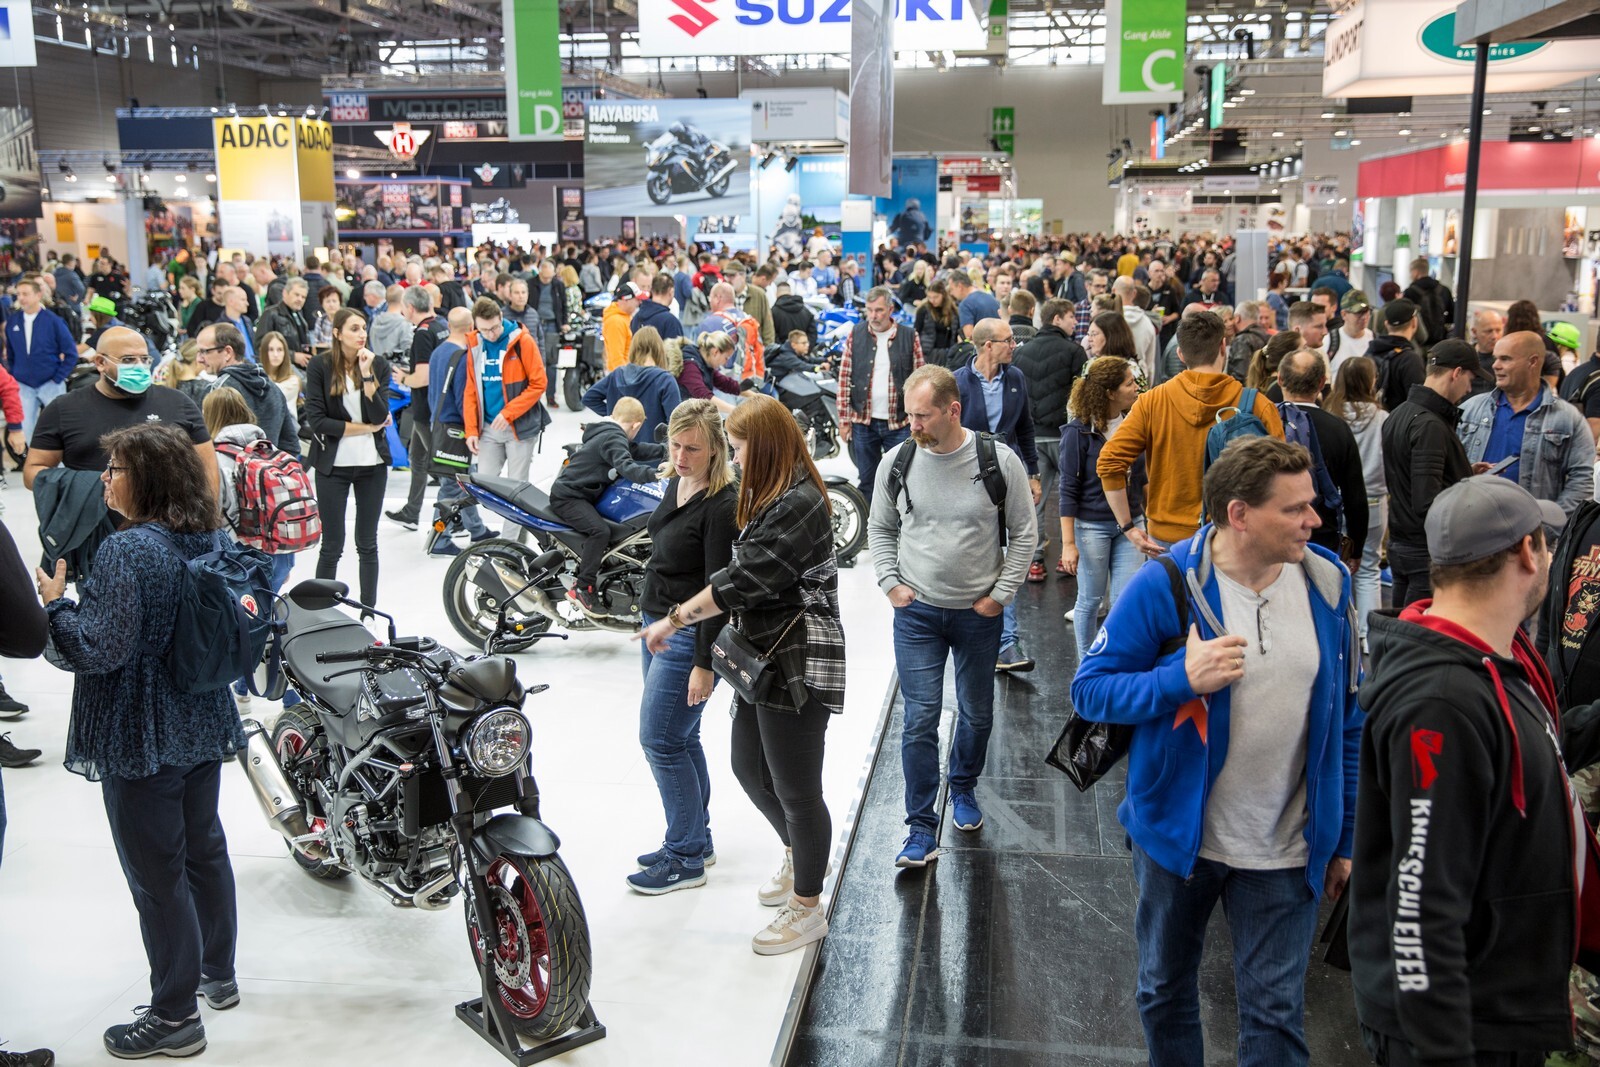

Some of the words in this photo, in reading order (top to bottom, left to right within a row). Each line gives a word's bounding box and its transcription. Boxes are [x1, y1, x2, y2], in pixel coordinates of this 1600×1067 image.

[735, 0, 963, 25] SUZKI
[1123, 30, 1148, 42] Gang
[1456, 47, 1516, 58] BATRIES
[1141, 48, 1176, 92] C
[332, 108, 368, 120] MOLY
[534, 104, 560, 135] D
[589, 104, 659, 122] HAYABUSA
[221, 123, 289, 148] ADAC
[299, 124, 331, 150] ADAC
[435, 450, 469, 463] Kawasaki
